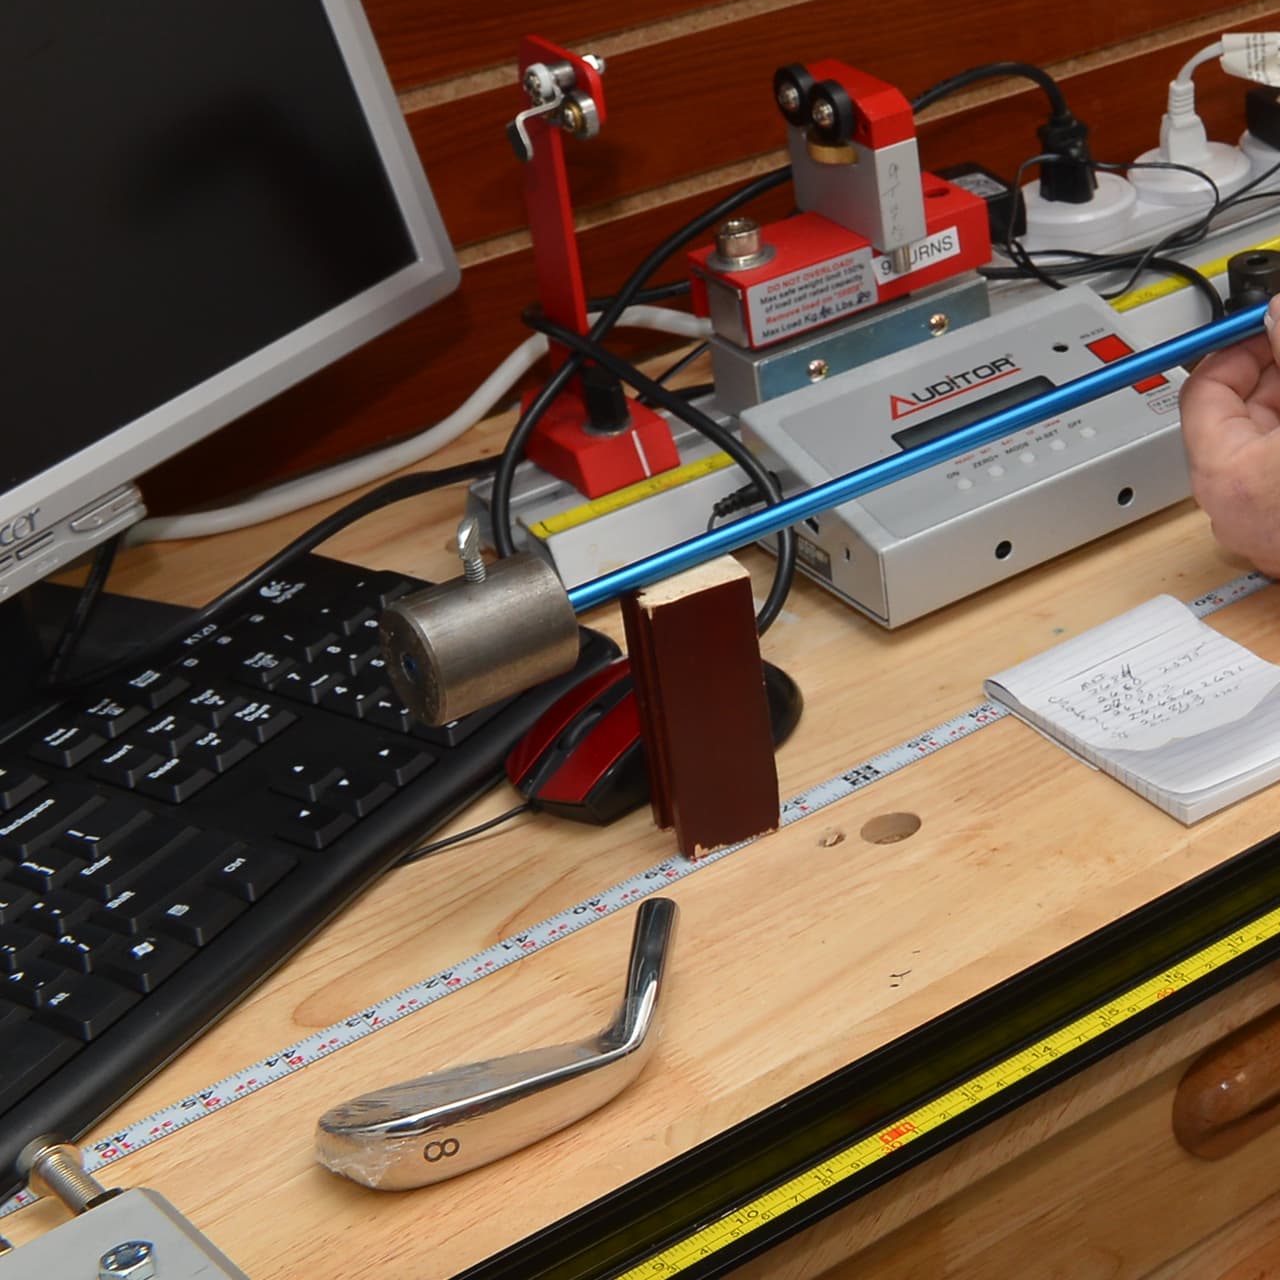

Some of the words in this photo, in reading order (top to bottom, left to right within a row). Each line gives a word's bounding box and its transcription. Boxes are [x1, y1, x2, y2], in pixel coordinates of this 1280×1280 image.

[881, 260, 892, 276] 9
[760, 295, 778, 306] Max
[779, 288, 797, 300] safe
[799, 281, 822, 297] weight
[765, 304, 775, 314] of
[775, 298, 793, 311] load
[794, 293, 808, 304] cell
[808, 286, 829, 300] rated
[829, 273, 864, 295] capacity
[767, 284, 782, 295] DO
[783, 276, 801, 291] NOT
[766, 308, 801, 325] Remove
[801, 301, 819, 314] load
[762, 326, 780, 338] Max
[781, 319, 803, 334] Load
[804, 311, 819, 326] Kg
[890, 356, 1018, 420] AUDITOR
[1005, 441, 1030, 455] MODE
[0, 507, 41, 547] cer
[907, 733, 934, 750] 35
[80, 855, 113, 877] Enter
[104, 891, 136, 911] Shift
[573, 897, 602, 915] 40
[502, 933, 529, 951] 41
[423, 970, 455, 990] 42
[345, 1008, 377, 1029] 43
[960, 1083, 984, 1100] 13
[1031, 1044, 1053, 1061] 14
[1097, 1007, 1121, 1022] 15
[1164, 970, 1185, 985] 16
[1226, 934, 1246, 950] 17
[264, 1049, 297, 1070] 44
[180, 1090, 215, 1112] 45
[94, 1131, 129, 1154] 46
[101, 1142, 135, 1160] 10
[735, 1208, 760, 1226] 10
[813, 1166, 835, 1183] 11
